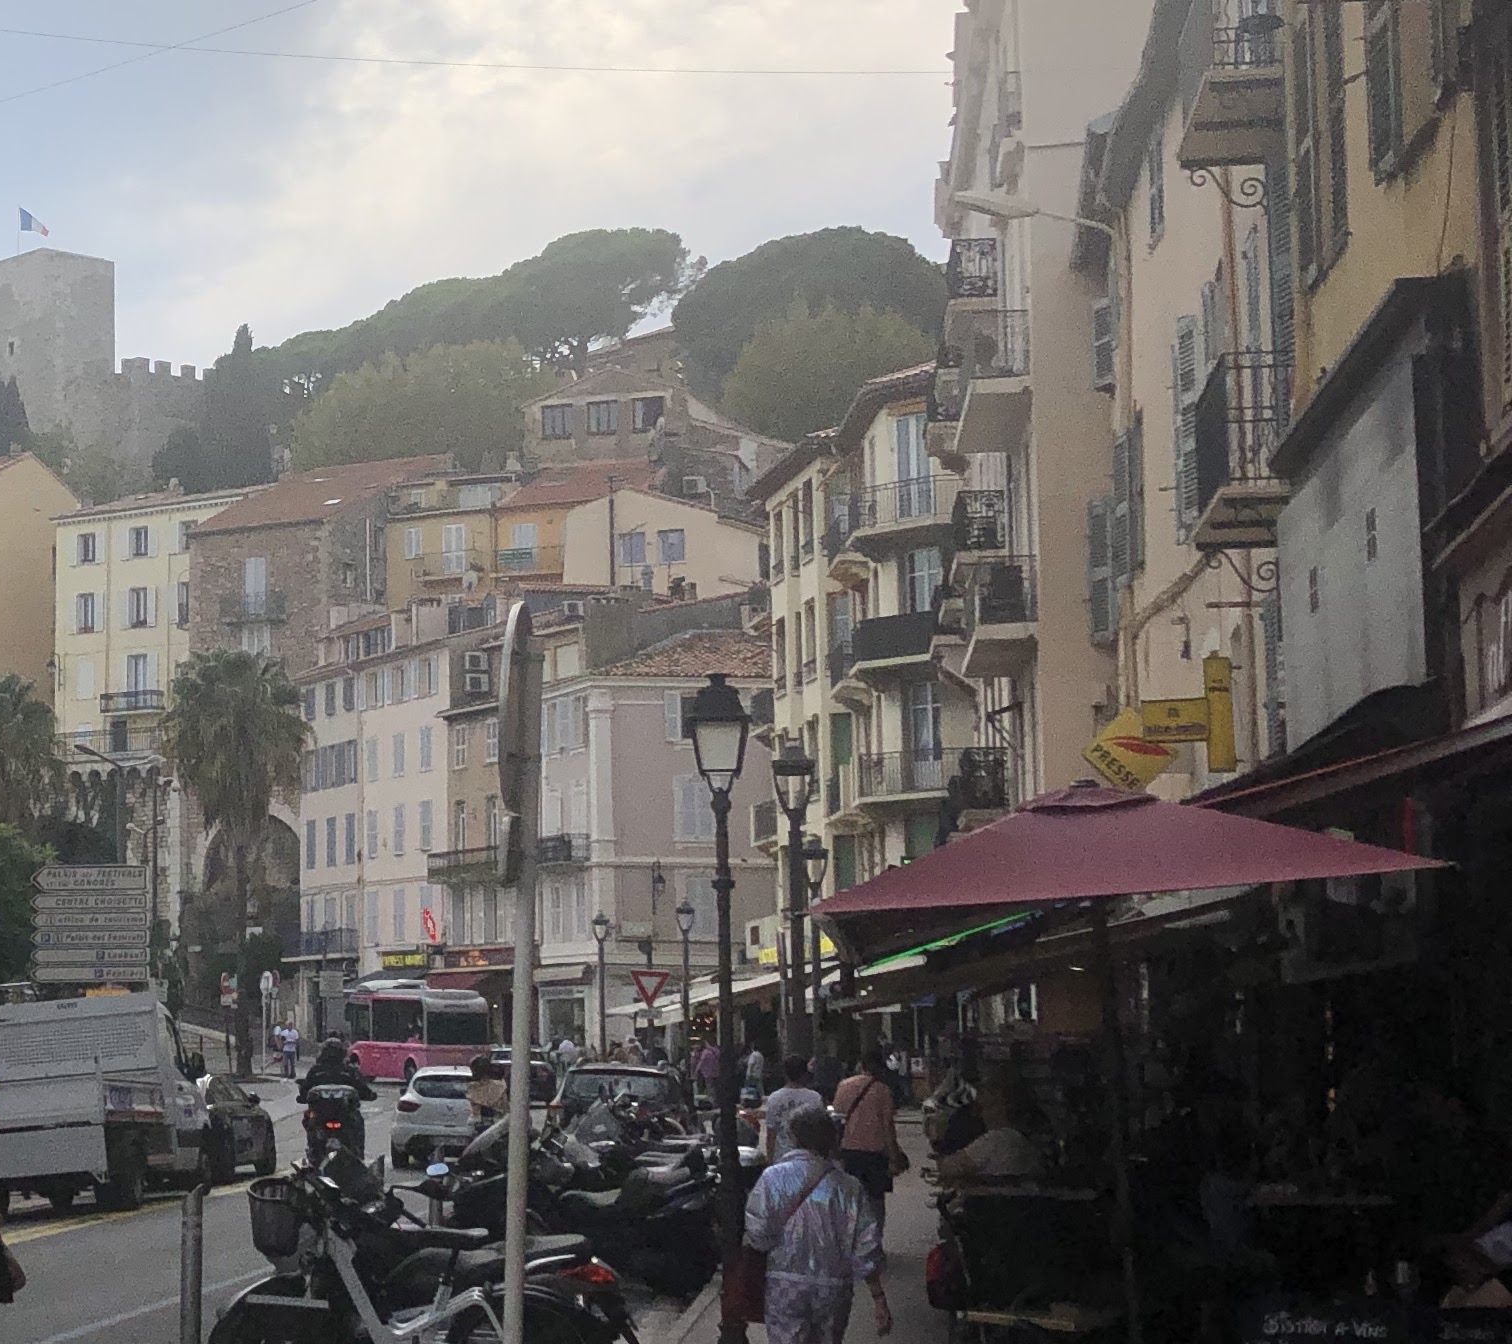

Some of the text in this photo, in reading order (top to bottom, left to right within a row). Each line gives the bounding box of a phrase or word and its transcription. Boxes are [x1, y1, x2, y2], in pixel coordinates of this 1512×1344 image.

[1091, 743, 1141, 790] PRESSE
[46, 869, 77, 879] PALAIS
[96, 869, 144, 879] FESTIVALS
